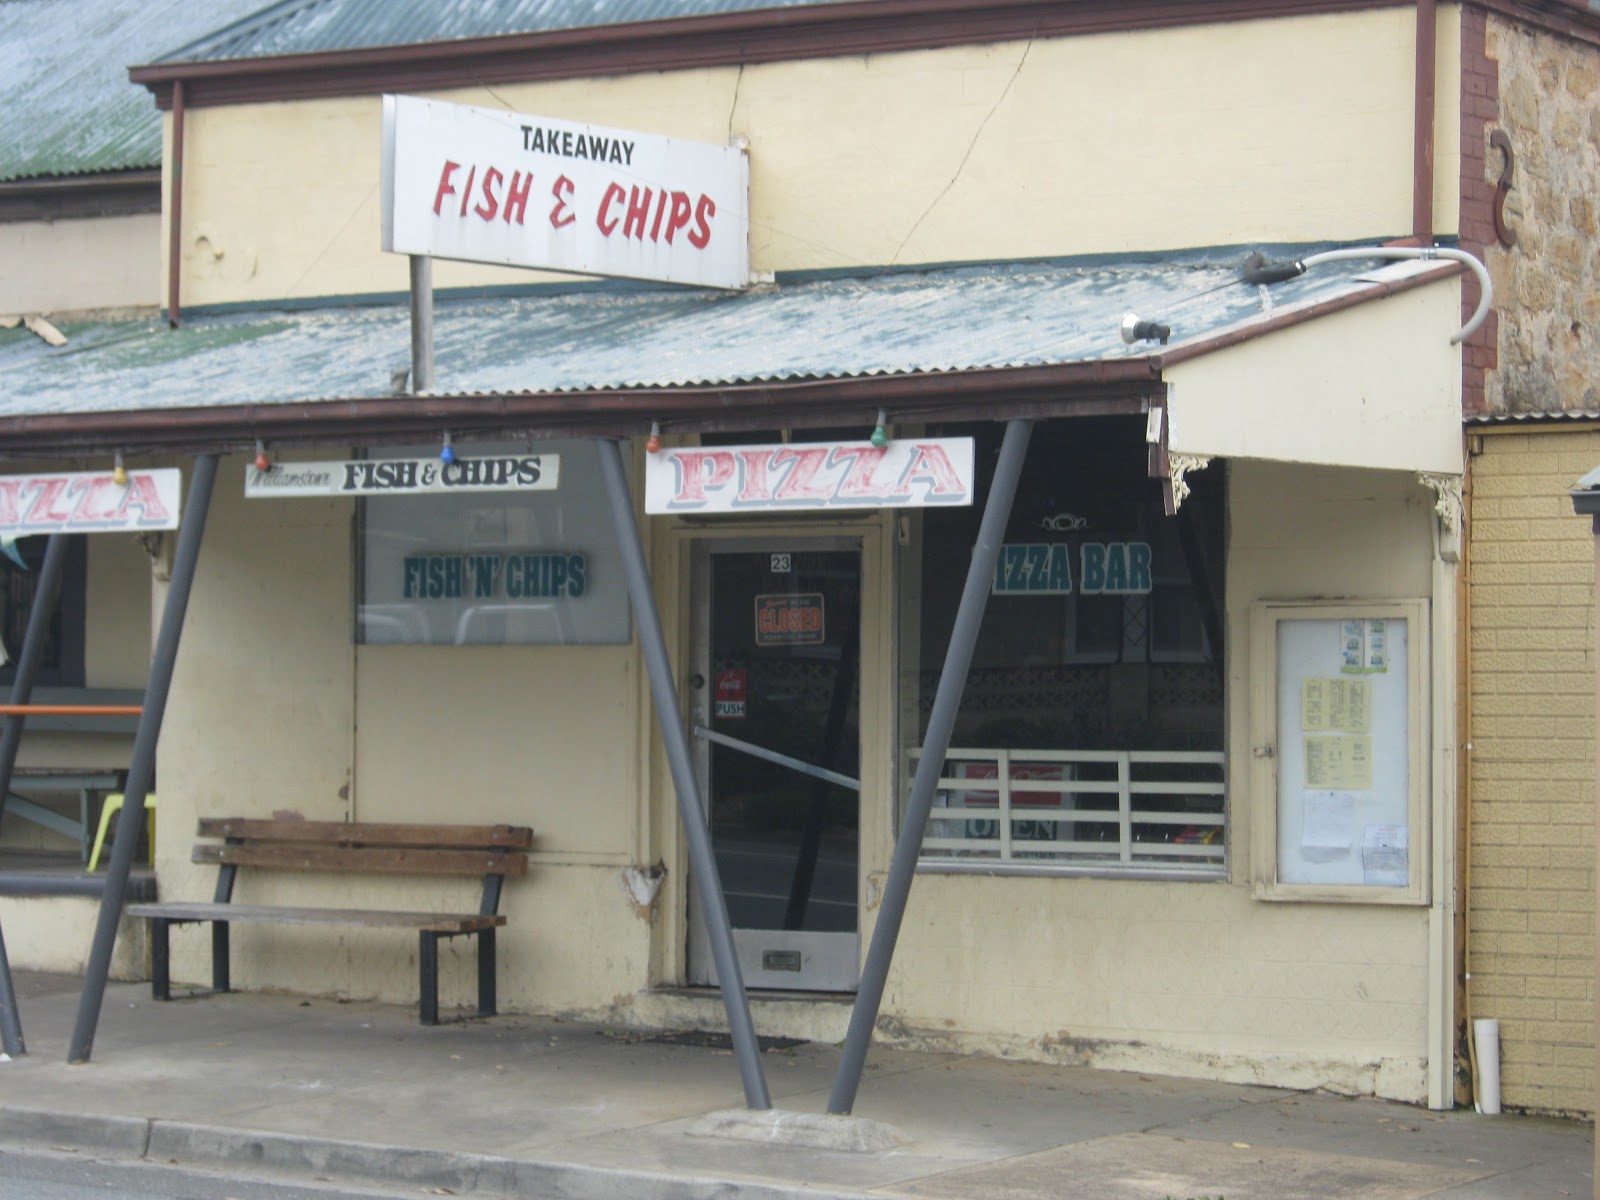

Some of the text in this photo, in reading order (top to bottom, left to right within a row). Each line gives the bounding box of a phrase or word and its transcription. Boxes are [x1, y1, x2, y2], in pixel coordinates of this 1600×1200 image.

[520, 124, 635, 166] TAKEAWAY
[433, 160, 716, 250] FISH & CHIPS
[342, 461, 418, 490] FISH
[421, 462, 437, 486] &
[440, 457, 541, 488] CHIPS
[667, 444, 967, 509] PIZZA
[403, 554, 585, 598] FISH 'N' CHIPS
[772, 556, 790, 570] 23
[973, 542, 1152, 595] IZZA BAR
[759, 607, 821, 633] CLOSED
[717, 703, 744, 715] PUSH
[968, 818, 1057, 840] OEN
